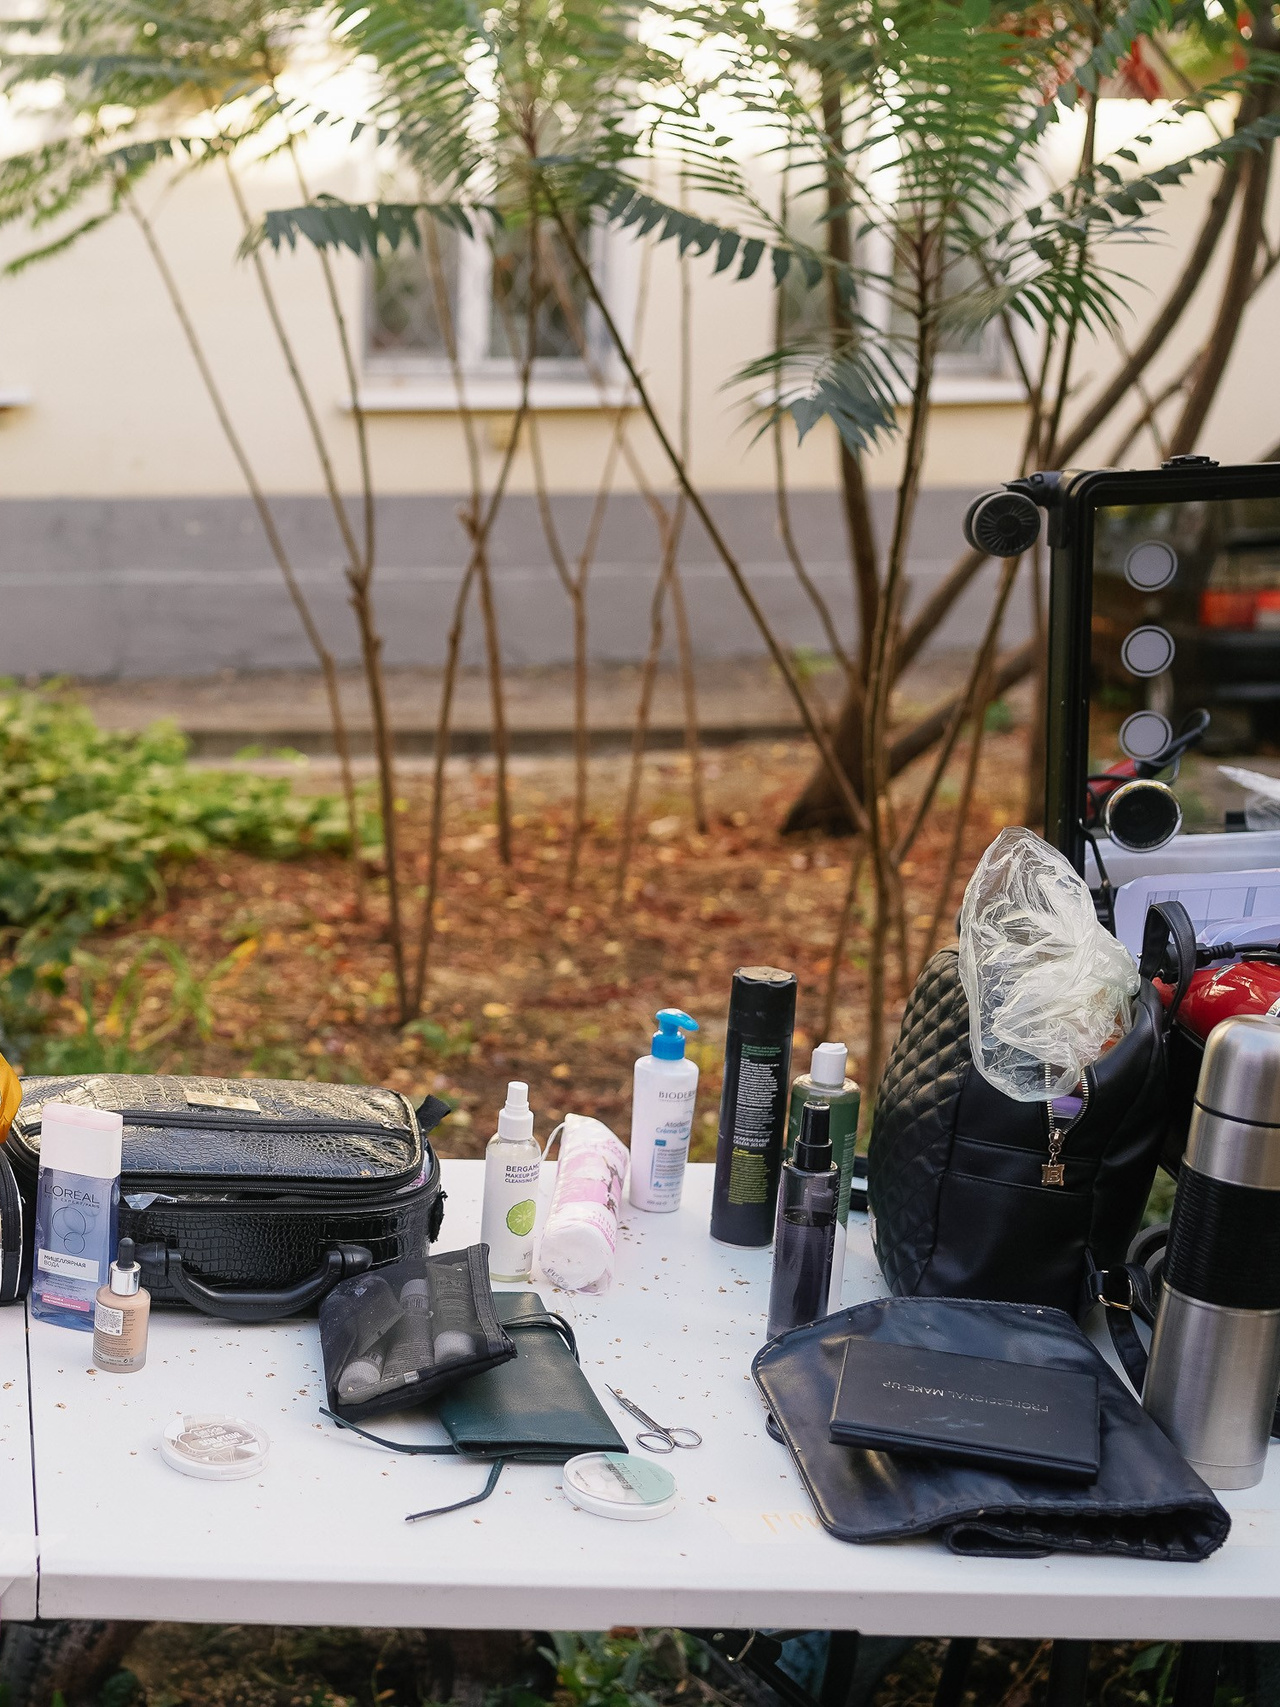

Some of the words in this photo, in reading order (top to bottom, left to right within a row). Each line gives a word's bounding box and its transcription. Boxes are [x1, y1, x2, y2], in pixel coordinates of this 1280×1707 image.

[44, 1184, 100, 1205] L'ORÉAL
[43, 1254, 87, 1268] МИЦЕЛЛЯРНАЯ
[43, 1260, 60, 1268] ВОДА
[881, 1380, 944, 1397] MAKE-UP
